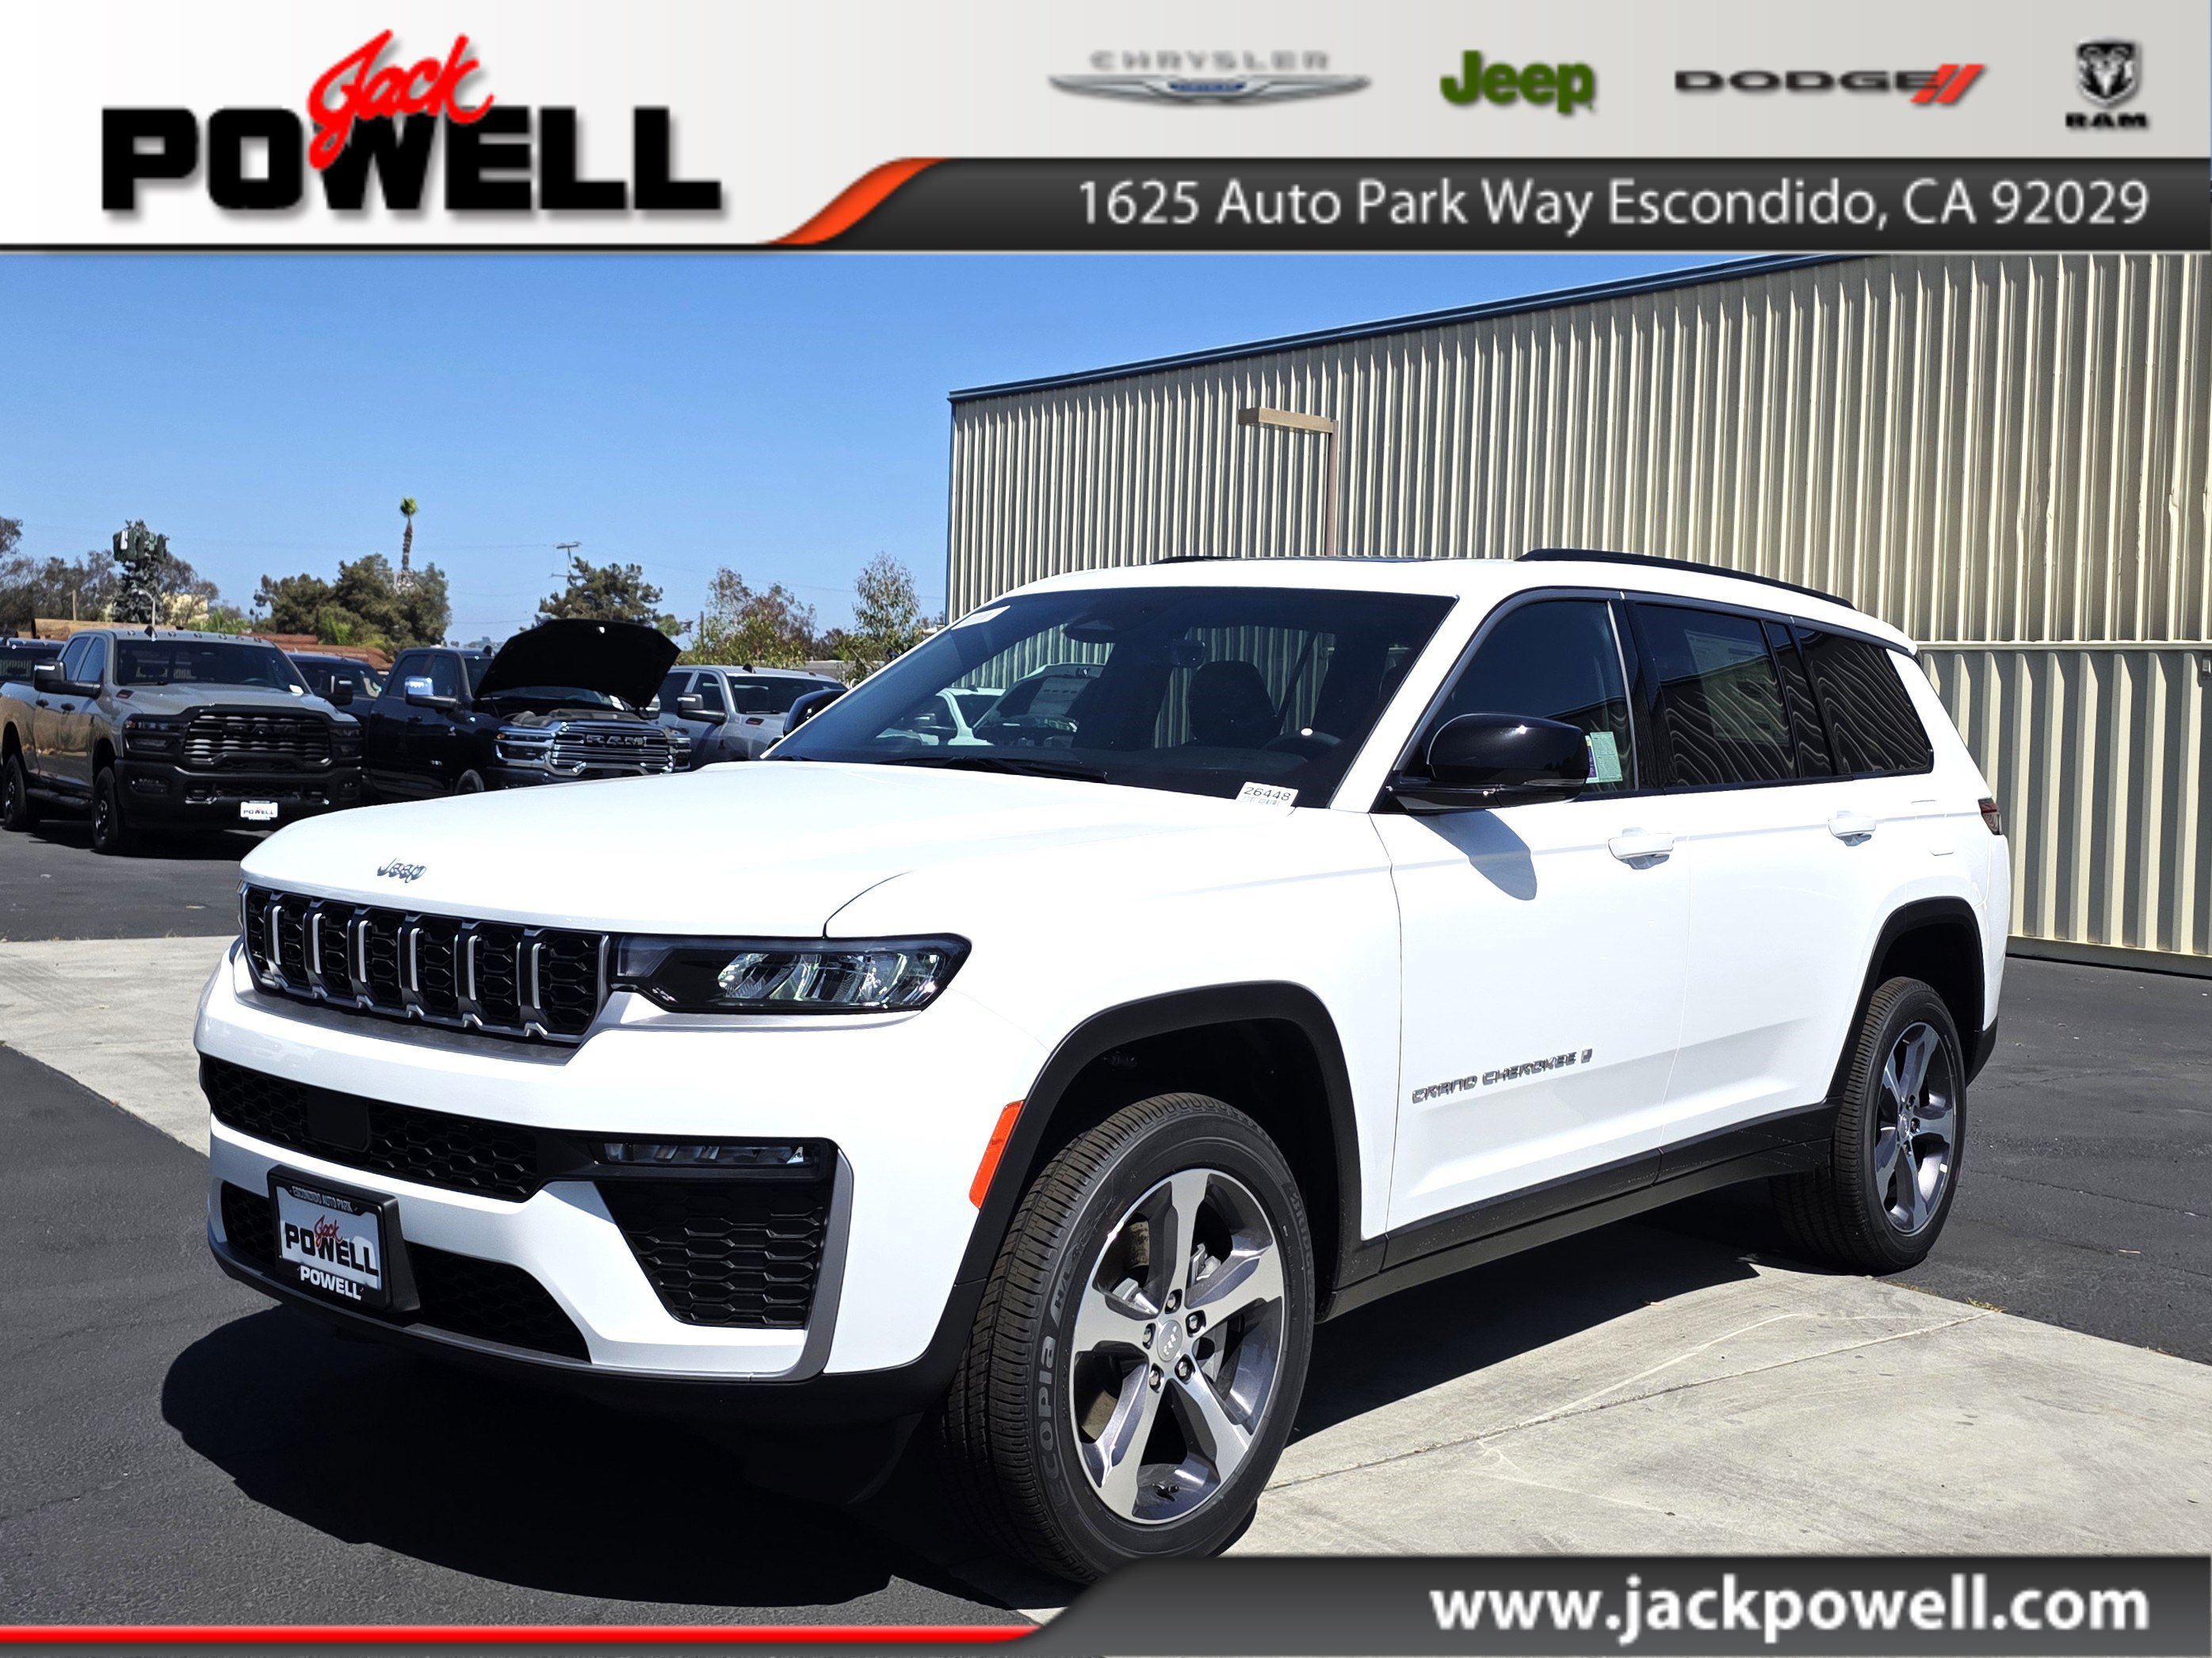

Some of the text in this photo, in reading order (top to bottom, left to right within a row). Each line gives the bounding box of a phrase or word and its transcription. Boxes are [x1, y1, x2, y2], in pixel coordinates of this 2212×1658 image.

[586, 734, 644, 746] RAM
[1244, 786, 1291, 801] 26448
[377, 858, 427, 884] Jeep
[1412, 1075, 1478, 1104] GRAND
[1482, 1052, 1577, 1086] CHEROKEE
[314, 1214, 343, 1248] Jack
[285, 1222, 380, 1278] POWELL
[300, 1265, 362, 1301] POWELL
[1038, 1335, 1068, 1506] ECOPIA
